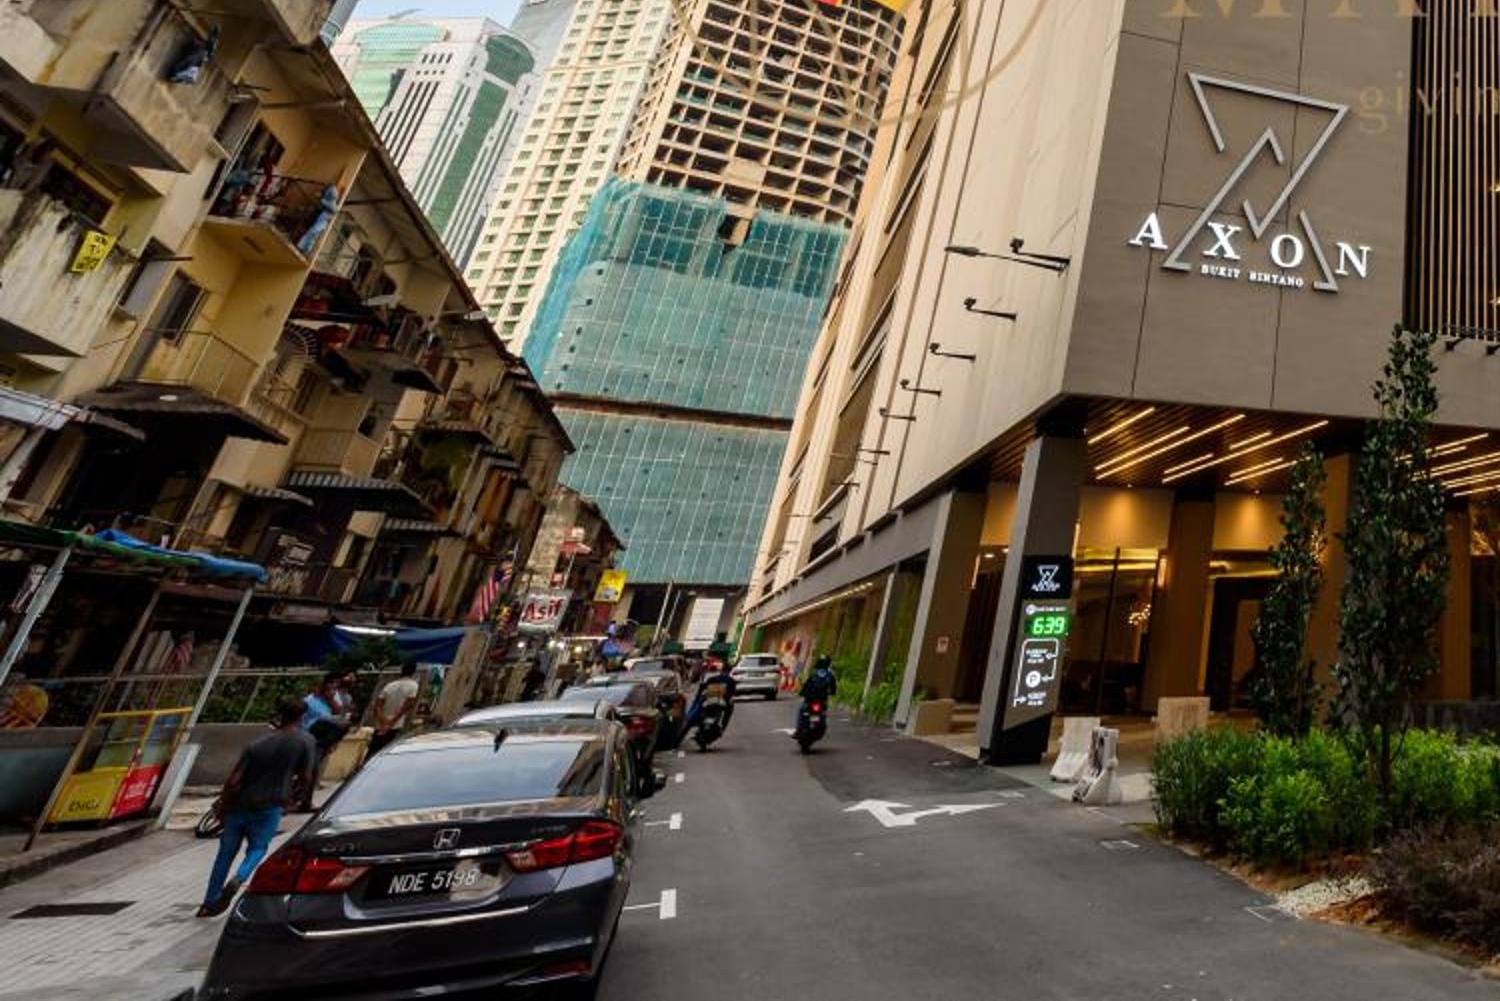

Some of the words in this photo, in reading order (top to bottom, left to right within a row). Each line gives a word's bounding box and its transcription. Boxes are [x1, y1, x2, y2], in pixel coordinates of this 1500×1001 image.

[1127, 212, 1372, 279] AXON
[1201, 264, 1241, 278] BUKIT
[1033, 616, 1065, 635] 639
[388, 872, 426, 895] NDE
